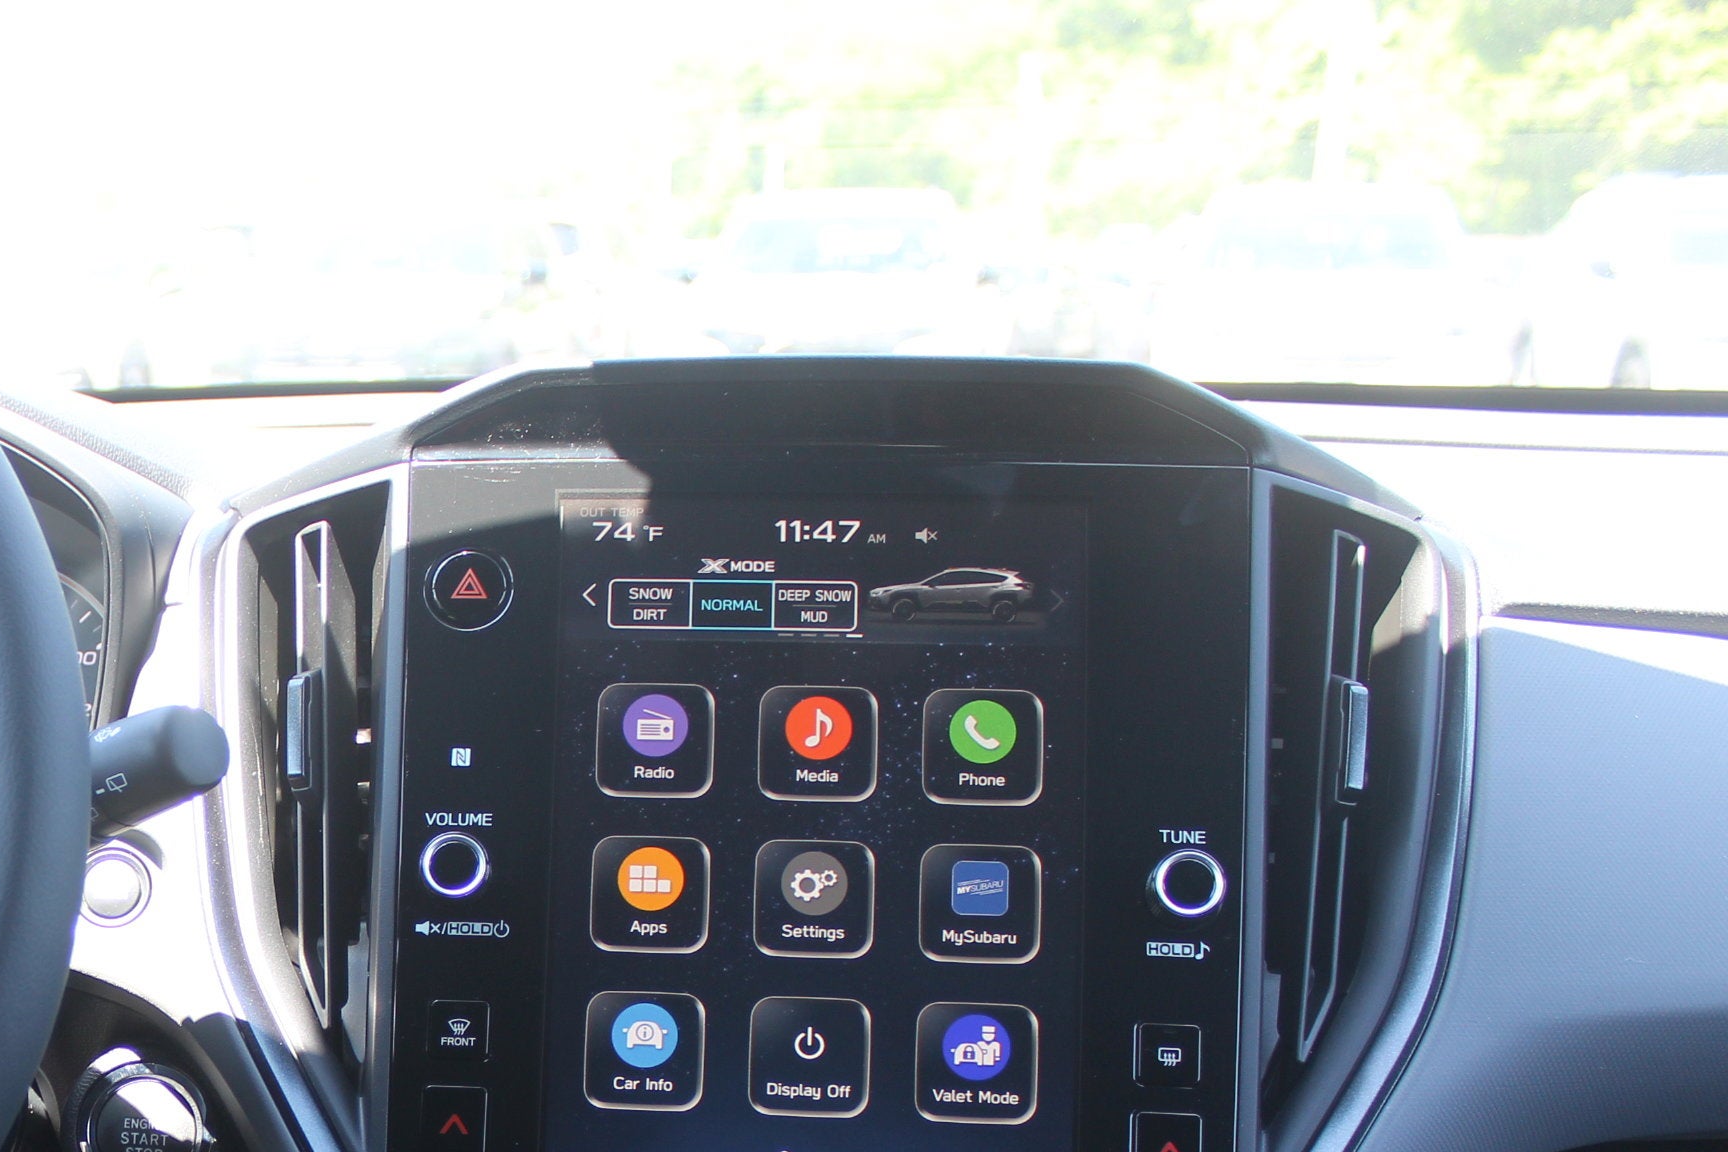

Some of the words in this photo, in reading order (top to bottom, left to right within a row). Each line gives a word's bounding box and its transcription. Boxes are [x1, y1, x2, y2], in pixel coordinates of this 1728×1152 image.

[580, 507, 608, 518] OUT
[610, 507, 644, 518] TEMP
[592, 521, 635, 542] 74
[774, 520, 861, 544] 11:47
[867, 533, 887, 544] AM
[628, 587, 673, 601] SNOW
[778, 590, 810, 602] DEEP
[815, 590, 852, 603] SNOW
[701, 598, 763, 612] NORMAL
[632, 608, 667, 621] DIRT
[800, 611, 828, 623] MUD
[633, 764, 675, 781] Radio
[795, 767, 839, 784] Media
[958, 771, 1005, 788] Phone
[425, 812, 493, 827] VOLUME
[1159, 829, 1206, 844] TUNE
[956, 880, 1004, 895] MYSUBARU
[630, 919, 668, 936] Apps
[781, 923, 845, 941] Settings
[942, 929, 1017, 946] MySubaru
[1147, 943, 1193, 957] HOLD
[441, 1036, 476, 1047] FRONT
[612, 1075, 642, 1092] Car
[646, 1075, 673, 1093] Info
[765, 1082, 821, 1101] Display
[826, 1083, 851, 1099] Off
[932, 1087, 972, 1104] Valet
[978, 1089, 1019, 1105] Mode
[121, 1132, 168, 1146] START
